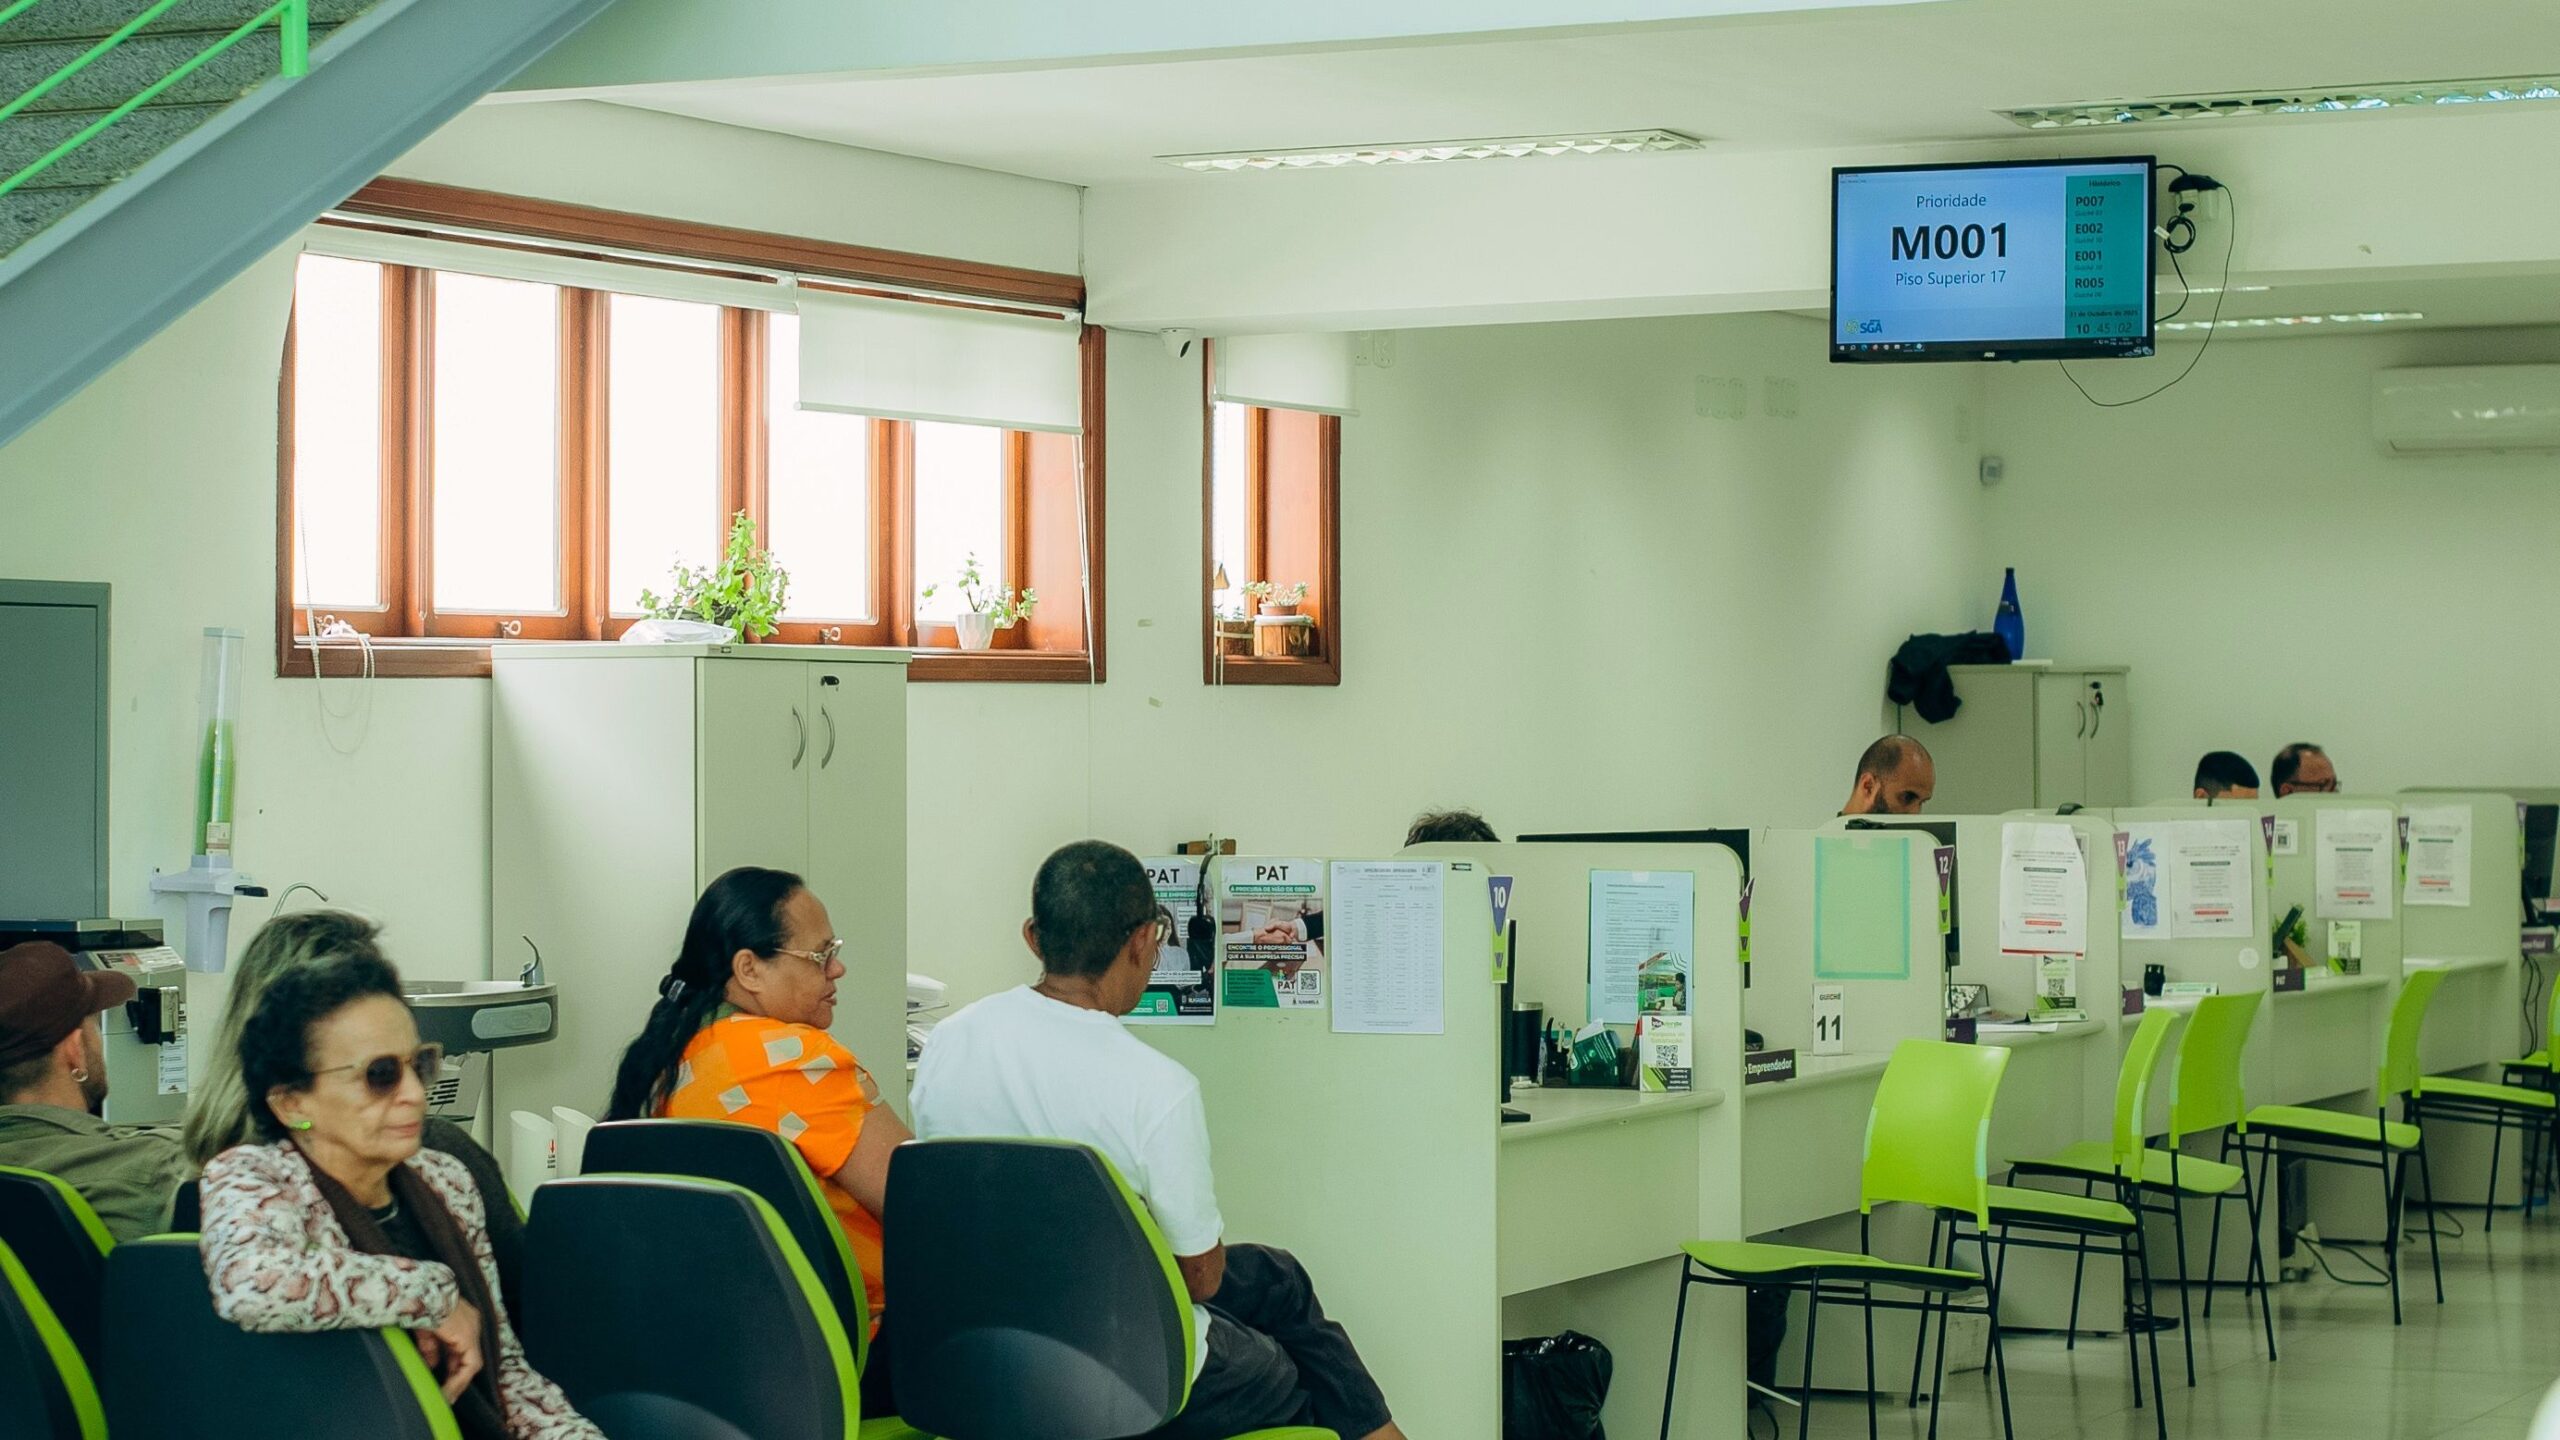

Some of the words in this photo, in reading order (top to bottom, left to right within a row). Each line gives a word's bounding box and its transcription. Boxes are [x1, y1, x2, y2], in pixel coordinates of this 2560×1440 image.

[1916, 194, 1986, 208] Prioridade
[2075, 196, 2105, 207] P007
[2075, 223, 2103, 234] E002
[1892, 222, 2006, 260] M001
[2075, 251, 2102, 261] E001
[1896, 273, 1923, 286] Piso
[1927, 270, 1985, 287] Superior
[1991, 270, 2006, 283] 17
[2074, 278, 2104, 288] R005
[1860, 322, 1882, 334] SGA
[2077, 324, 2090, 334] 10
[1939, 856, 1949, 874] 12
[1147, 869, 1180, 883] PAT
[1256, 865, 1289, 880] PAT
[1494, 886, 1506, 908] 10
[1277, 981, 1295, 989] PAT
[1817, 1015, 1840, 1041] 11
[1748, 1058, 1792, 1075] Empreendedor
